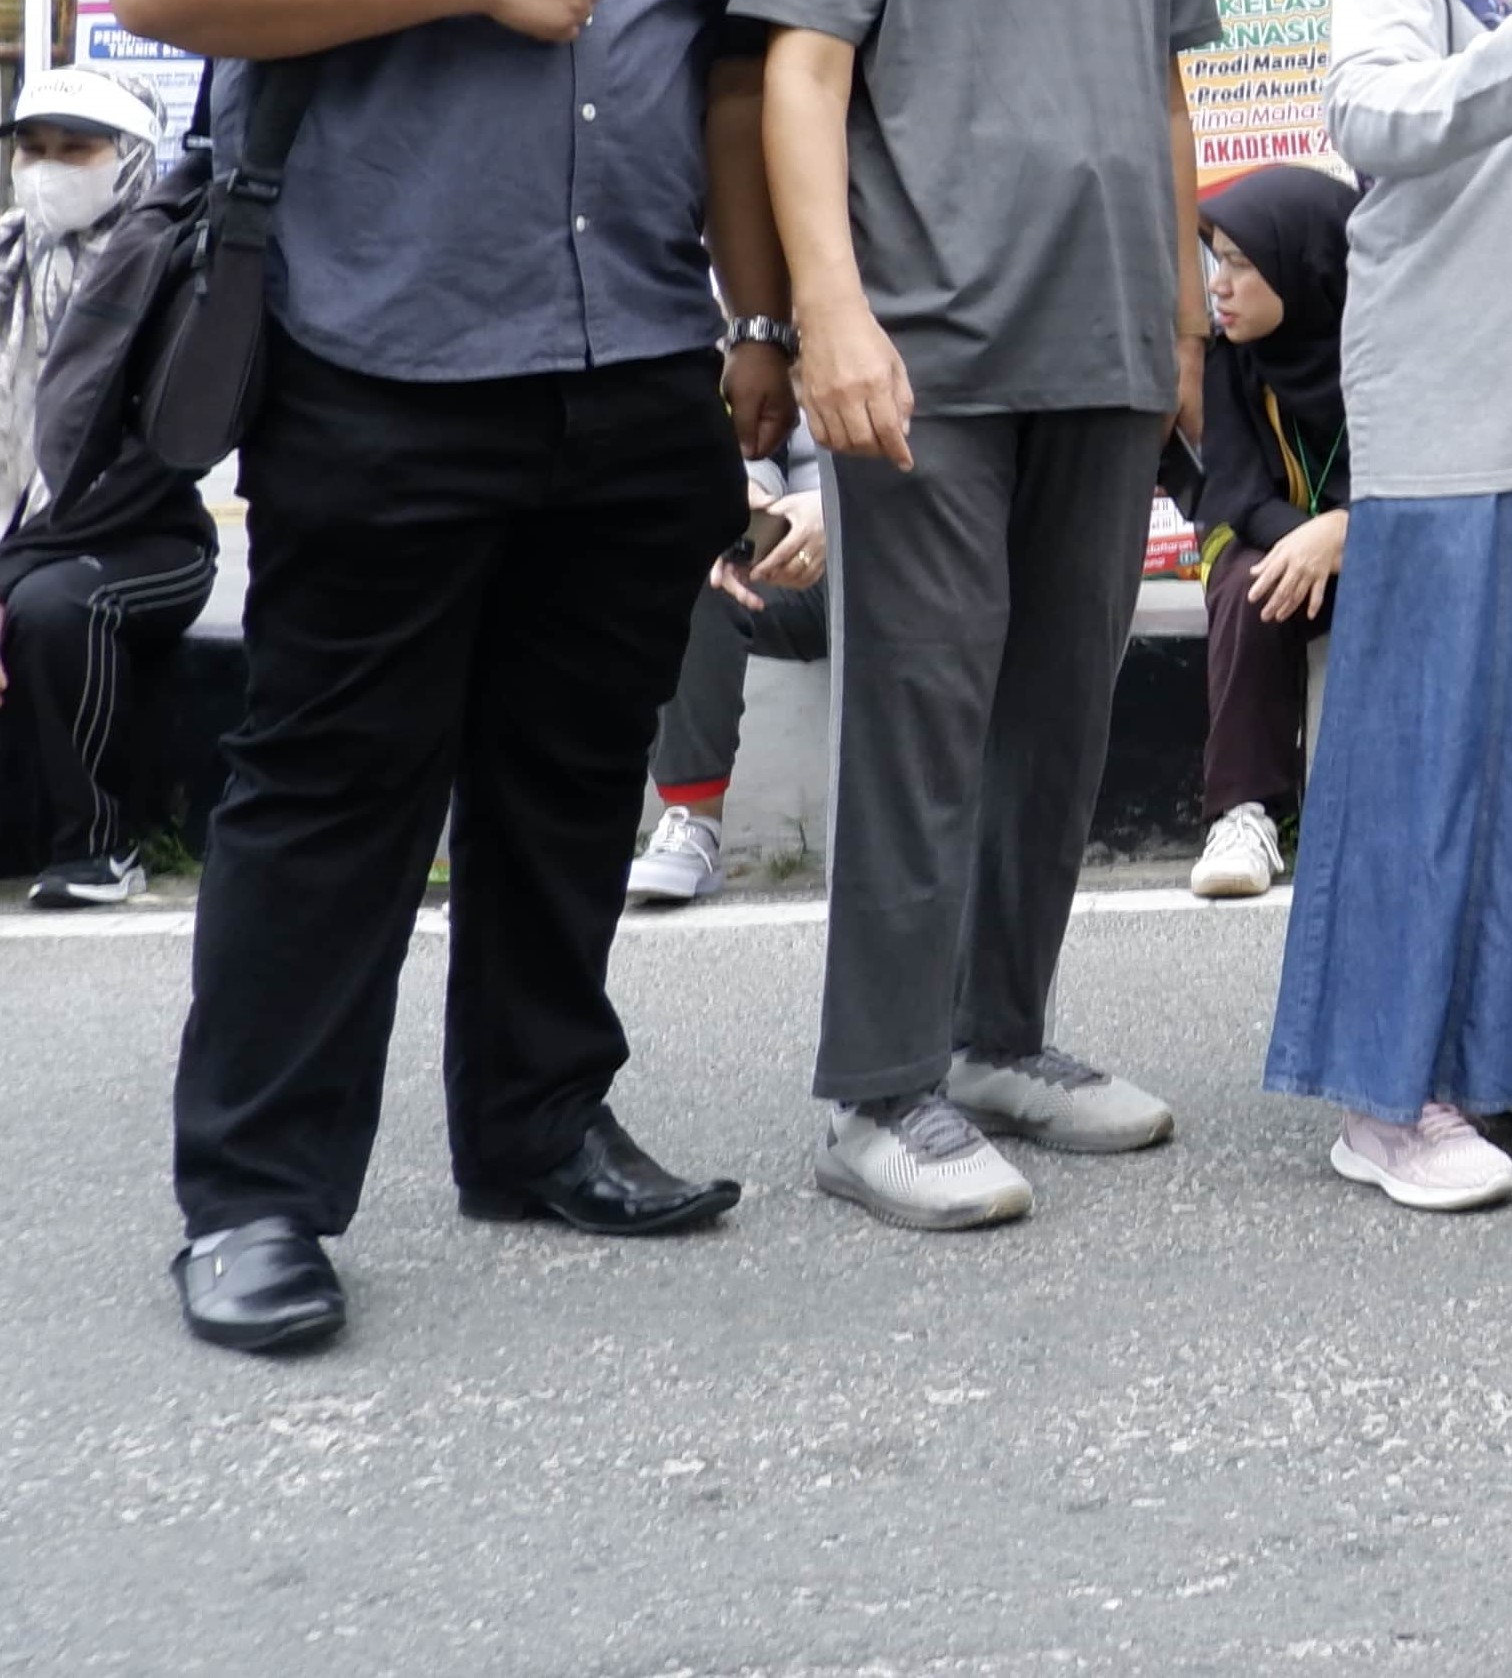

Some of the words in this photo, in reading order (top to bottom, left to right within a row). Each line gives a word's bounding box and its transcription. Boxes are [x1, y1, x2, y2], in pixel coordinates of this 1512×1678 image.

[109, 41, 158, 57] TEKNIK
[1194, 53, 1250, 77] Prodi
[1252, 48, 1330, 71] Manaje
[1198, 81, 1251, 103] Prodi
[1203, 134, 1312, 164] AKADEMIK
